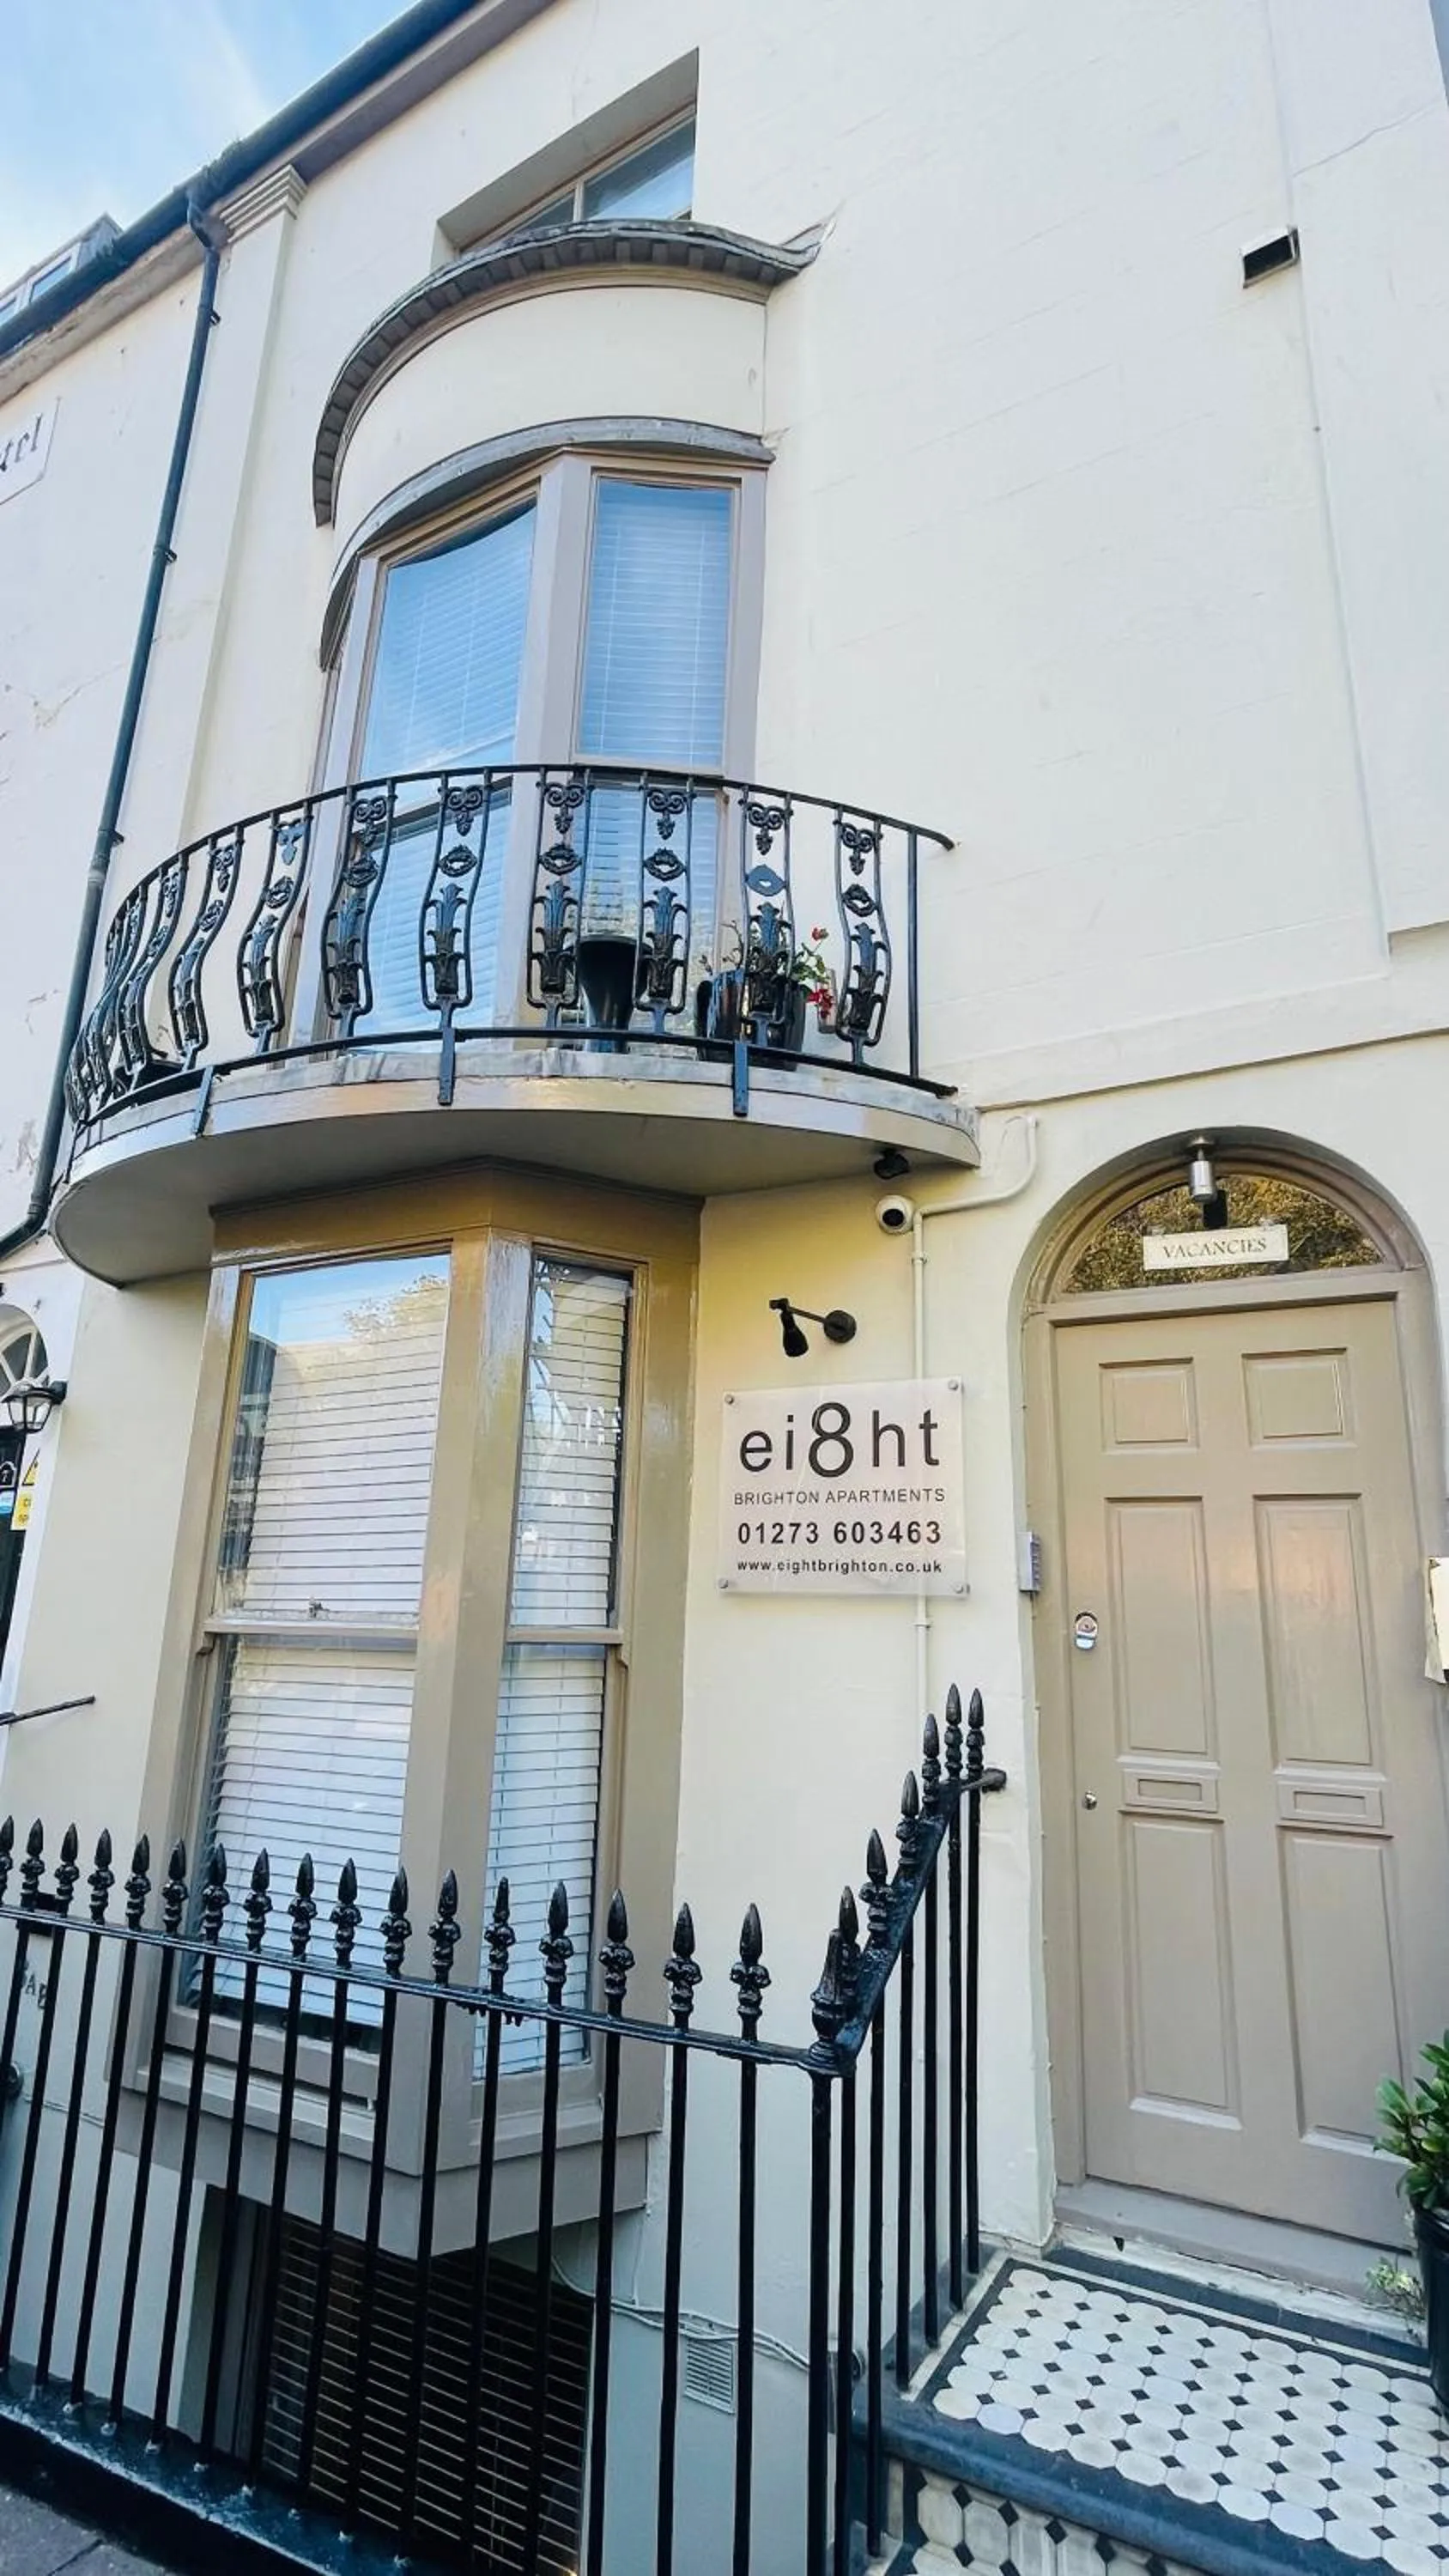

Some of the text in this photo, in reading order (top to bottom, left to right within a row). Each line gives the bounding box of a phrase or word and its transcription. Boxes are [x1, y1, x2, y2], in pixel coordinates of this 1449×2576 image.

[1162, 1237, 1268, 1259] VACANCIES
[739, 1401, 940, 1478] ei8ht
[734, 1488, 945, 1505] BRIGHTON APARTMENTS
[737, 1521, 941, 1544] 01273 603463
[737, 1559, 943, 1575] www.eightbrighton.co.uk
